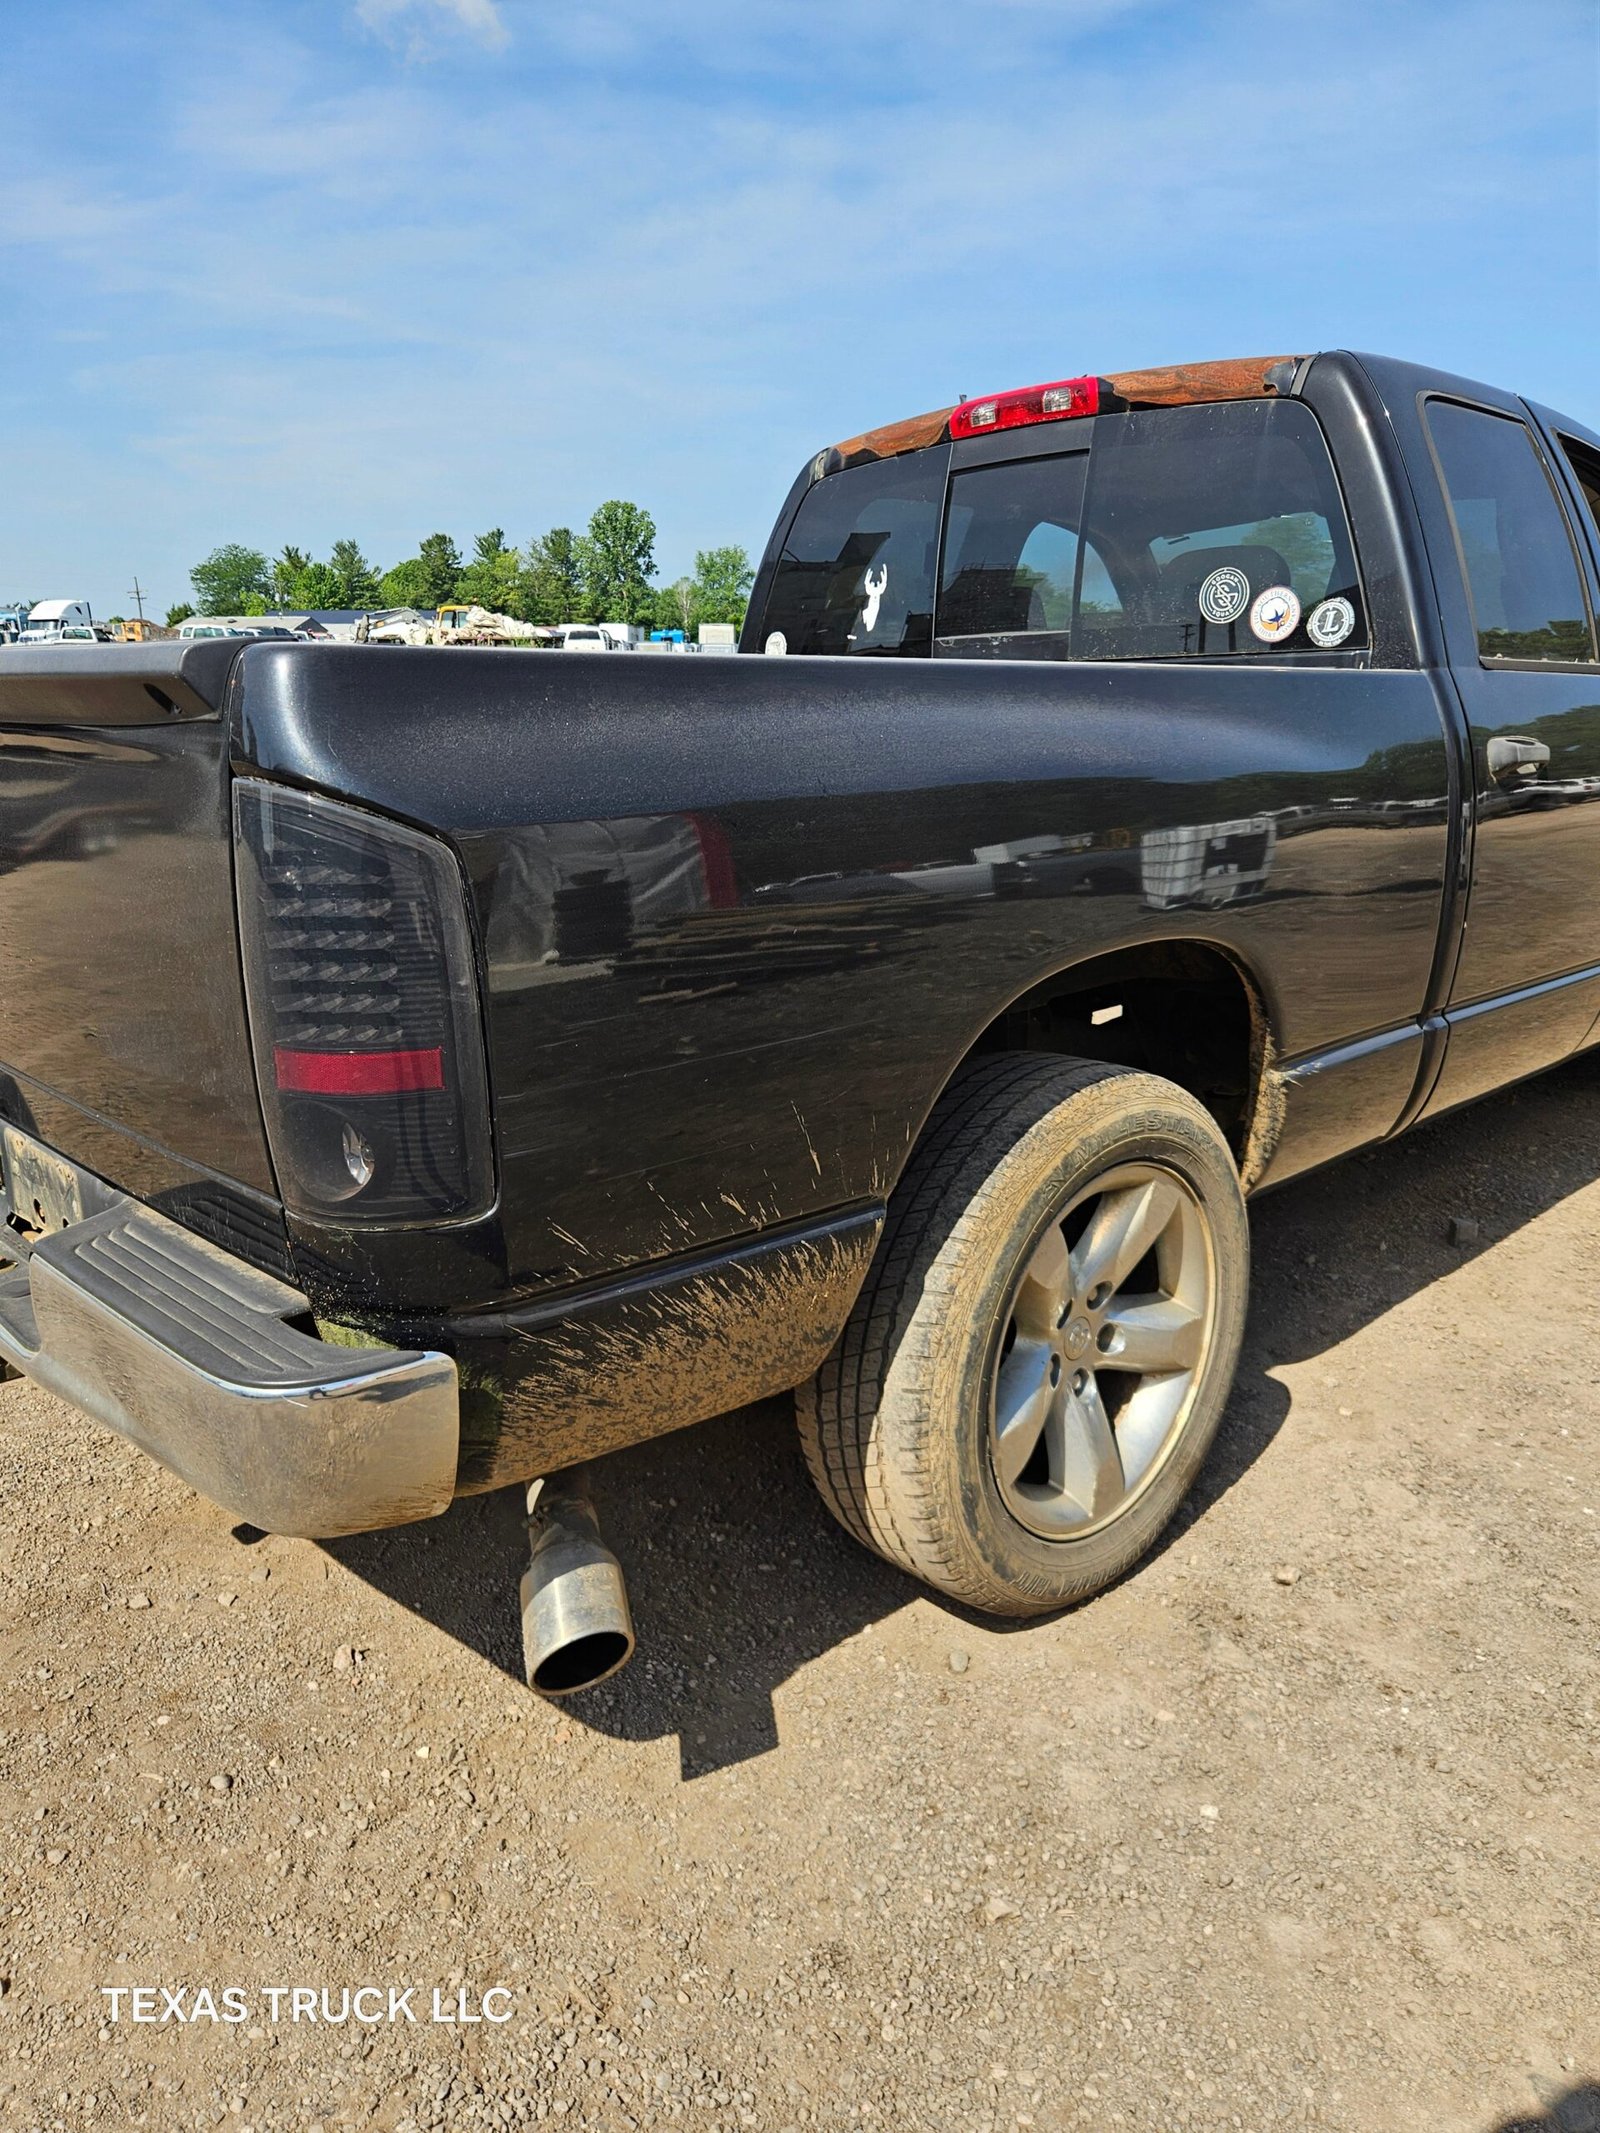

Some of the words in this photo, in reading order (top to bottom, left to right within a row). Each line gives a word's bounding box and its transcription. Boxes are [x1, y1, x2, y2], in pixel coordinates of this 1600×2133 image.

[1211, 573, 1239, 585] GOOGAN
[1212, 608, 1235, 618] SQUAD
[1321, 609, 1339, 633] L
